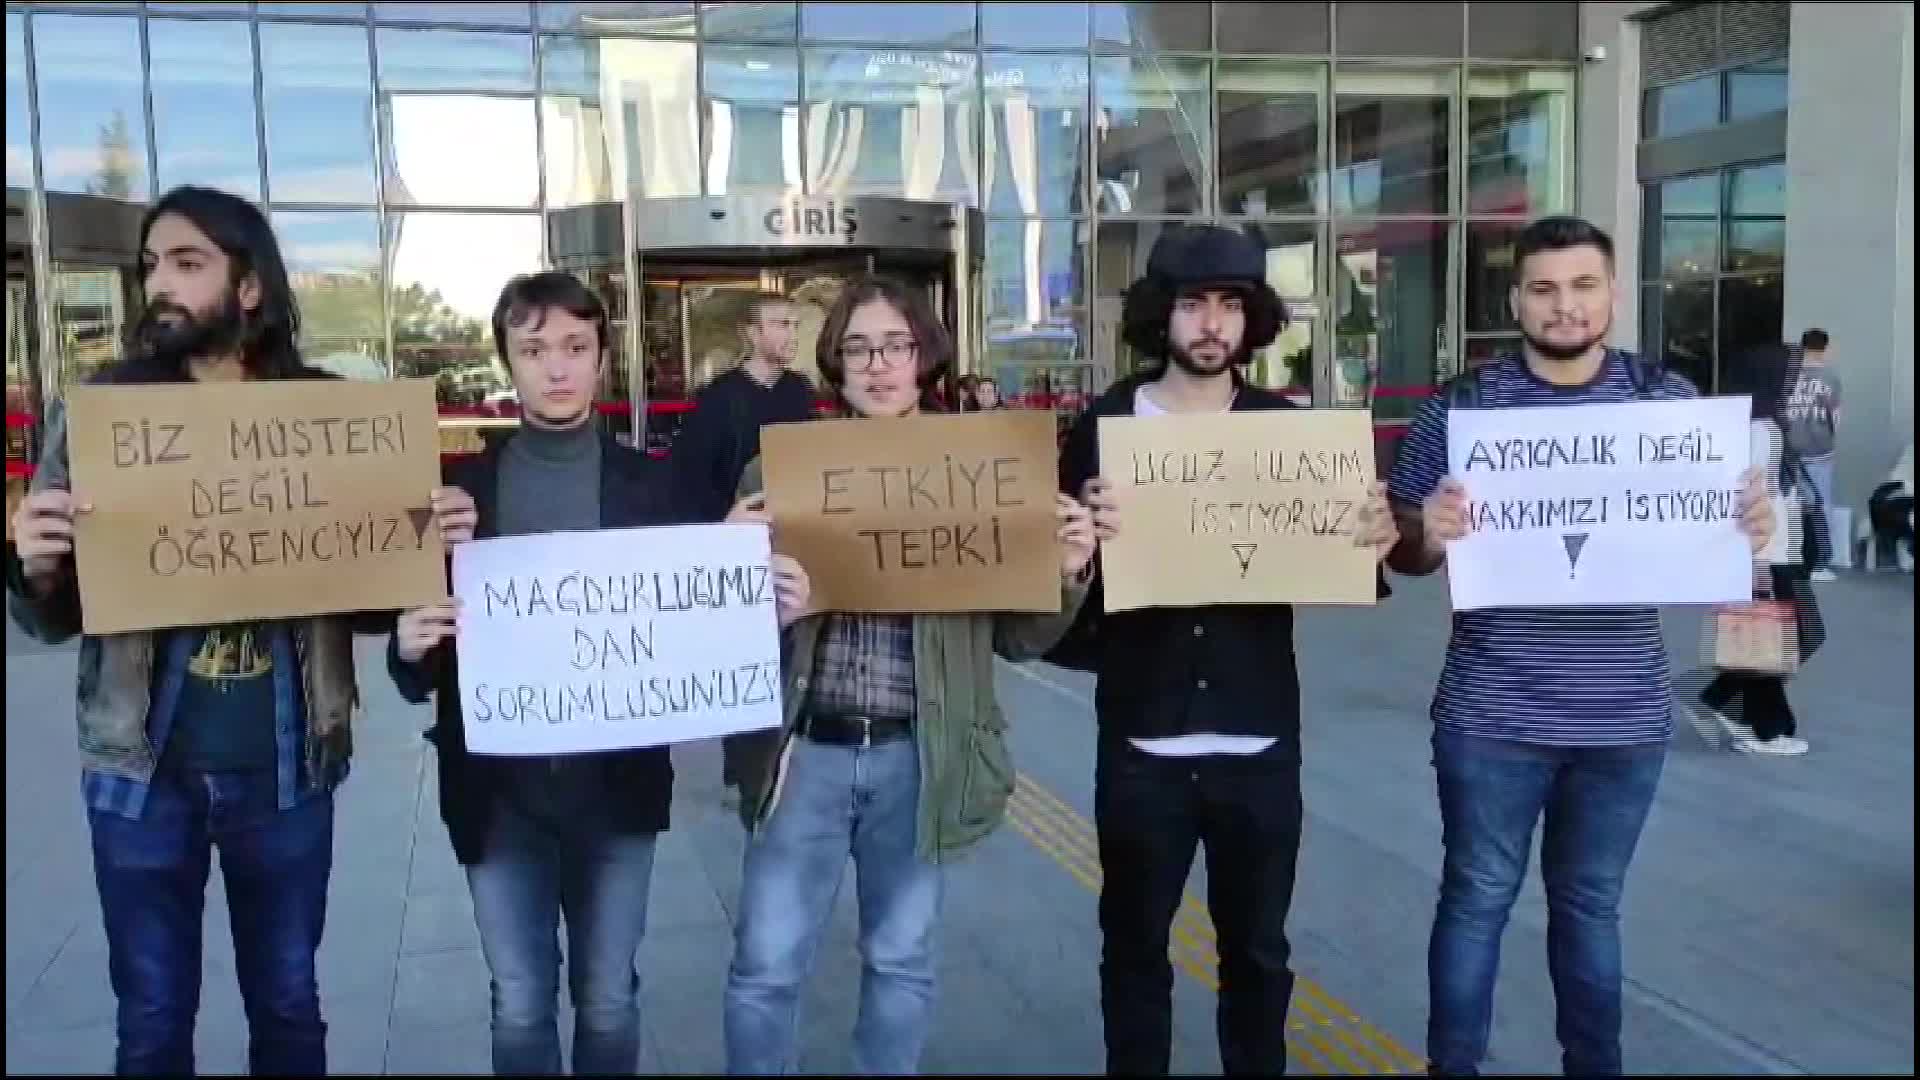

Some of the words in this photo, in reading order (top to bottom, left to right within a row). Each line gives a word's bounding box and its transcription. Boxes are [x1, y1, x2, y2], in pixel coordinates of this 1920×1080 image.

[764, 200, 858, 244] GİRİŞ
[112, 417, 192, 467] BİZ
[229, 411, 406, 462] MÜŞTERİ
[1465, 434, 1617, 472] AYRICALIK
[1638, 427, 1725, 465] DEĞİL
[822, 453, 1025, 514] ETKİYE
[1132, 449, 1227, 486] UCUZ
[192, 468, 328, 518] DEĞİL
[1190, 498, 1354, 536] İSTİYORUZ
[857, 516, 1003, 570] TEPKİ
[570, 621, 654, 669] DAN
